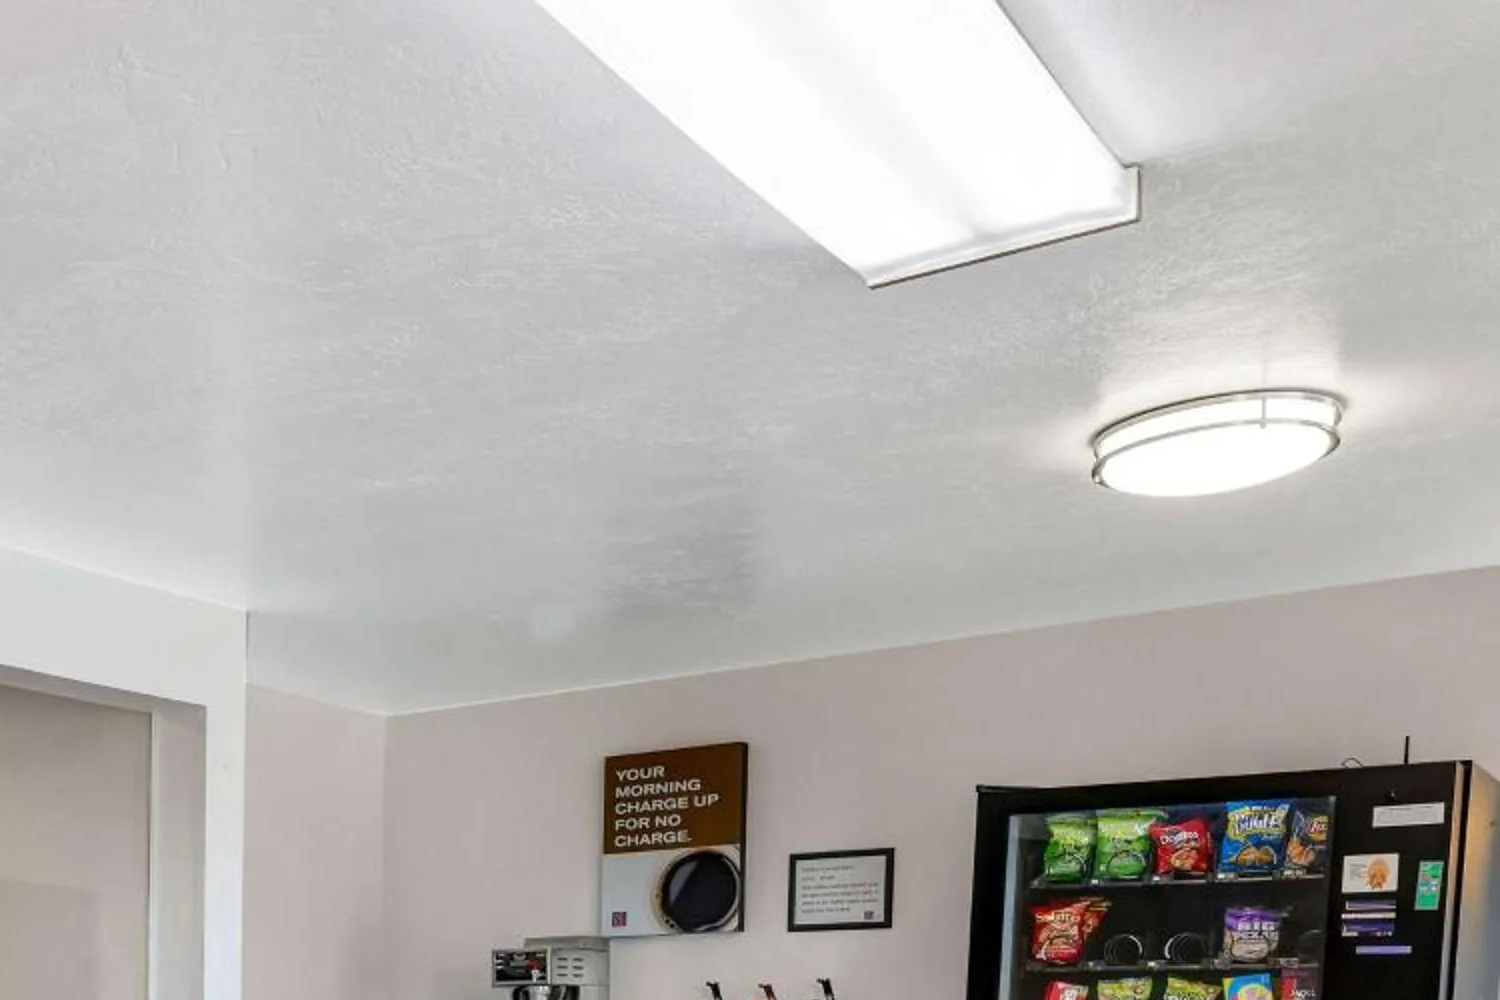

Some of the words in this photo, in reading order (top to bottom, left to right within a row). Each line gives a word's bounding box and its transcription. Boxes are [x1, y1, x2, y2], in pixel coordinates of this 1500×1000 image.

[616, 765, 665, 782] YOUR
[615, 779, 701, 799] MORNING
[615, 797, 689, 815] CHARGE
[694, 793, 719, 808] UP
[615, 818, 650, 832] FOR
[655, 814, 681, 828] NO
[615, 830, 693, 847] CHARGE.
